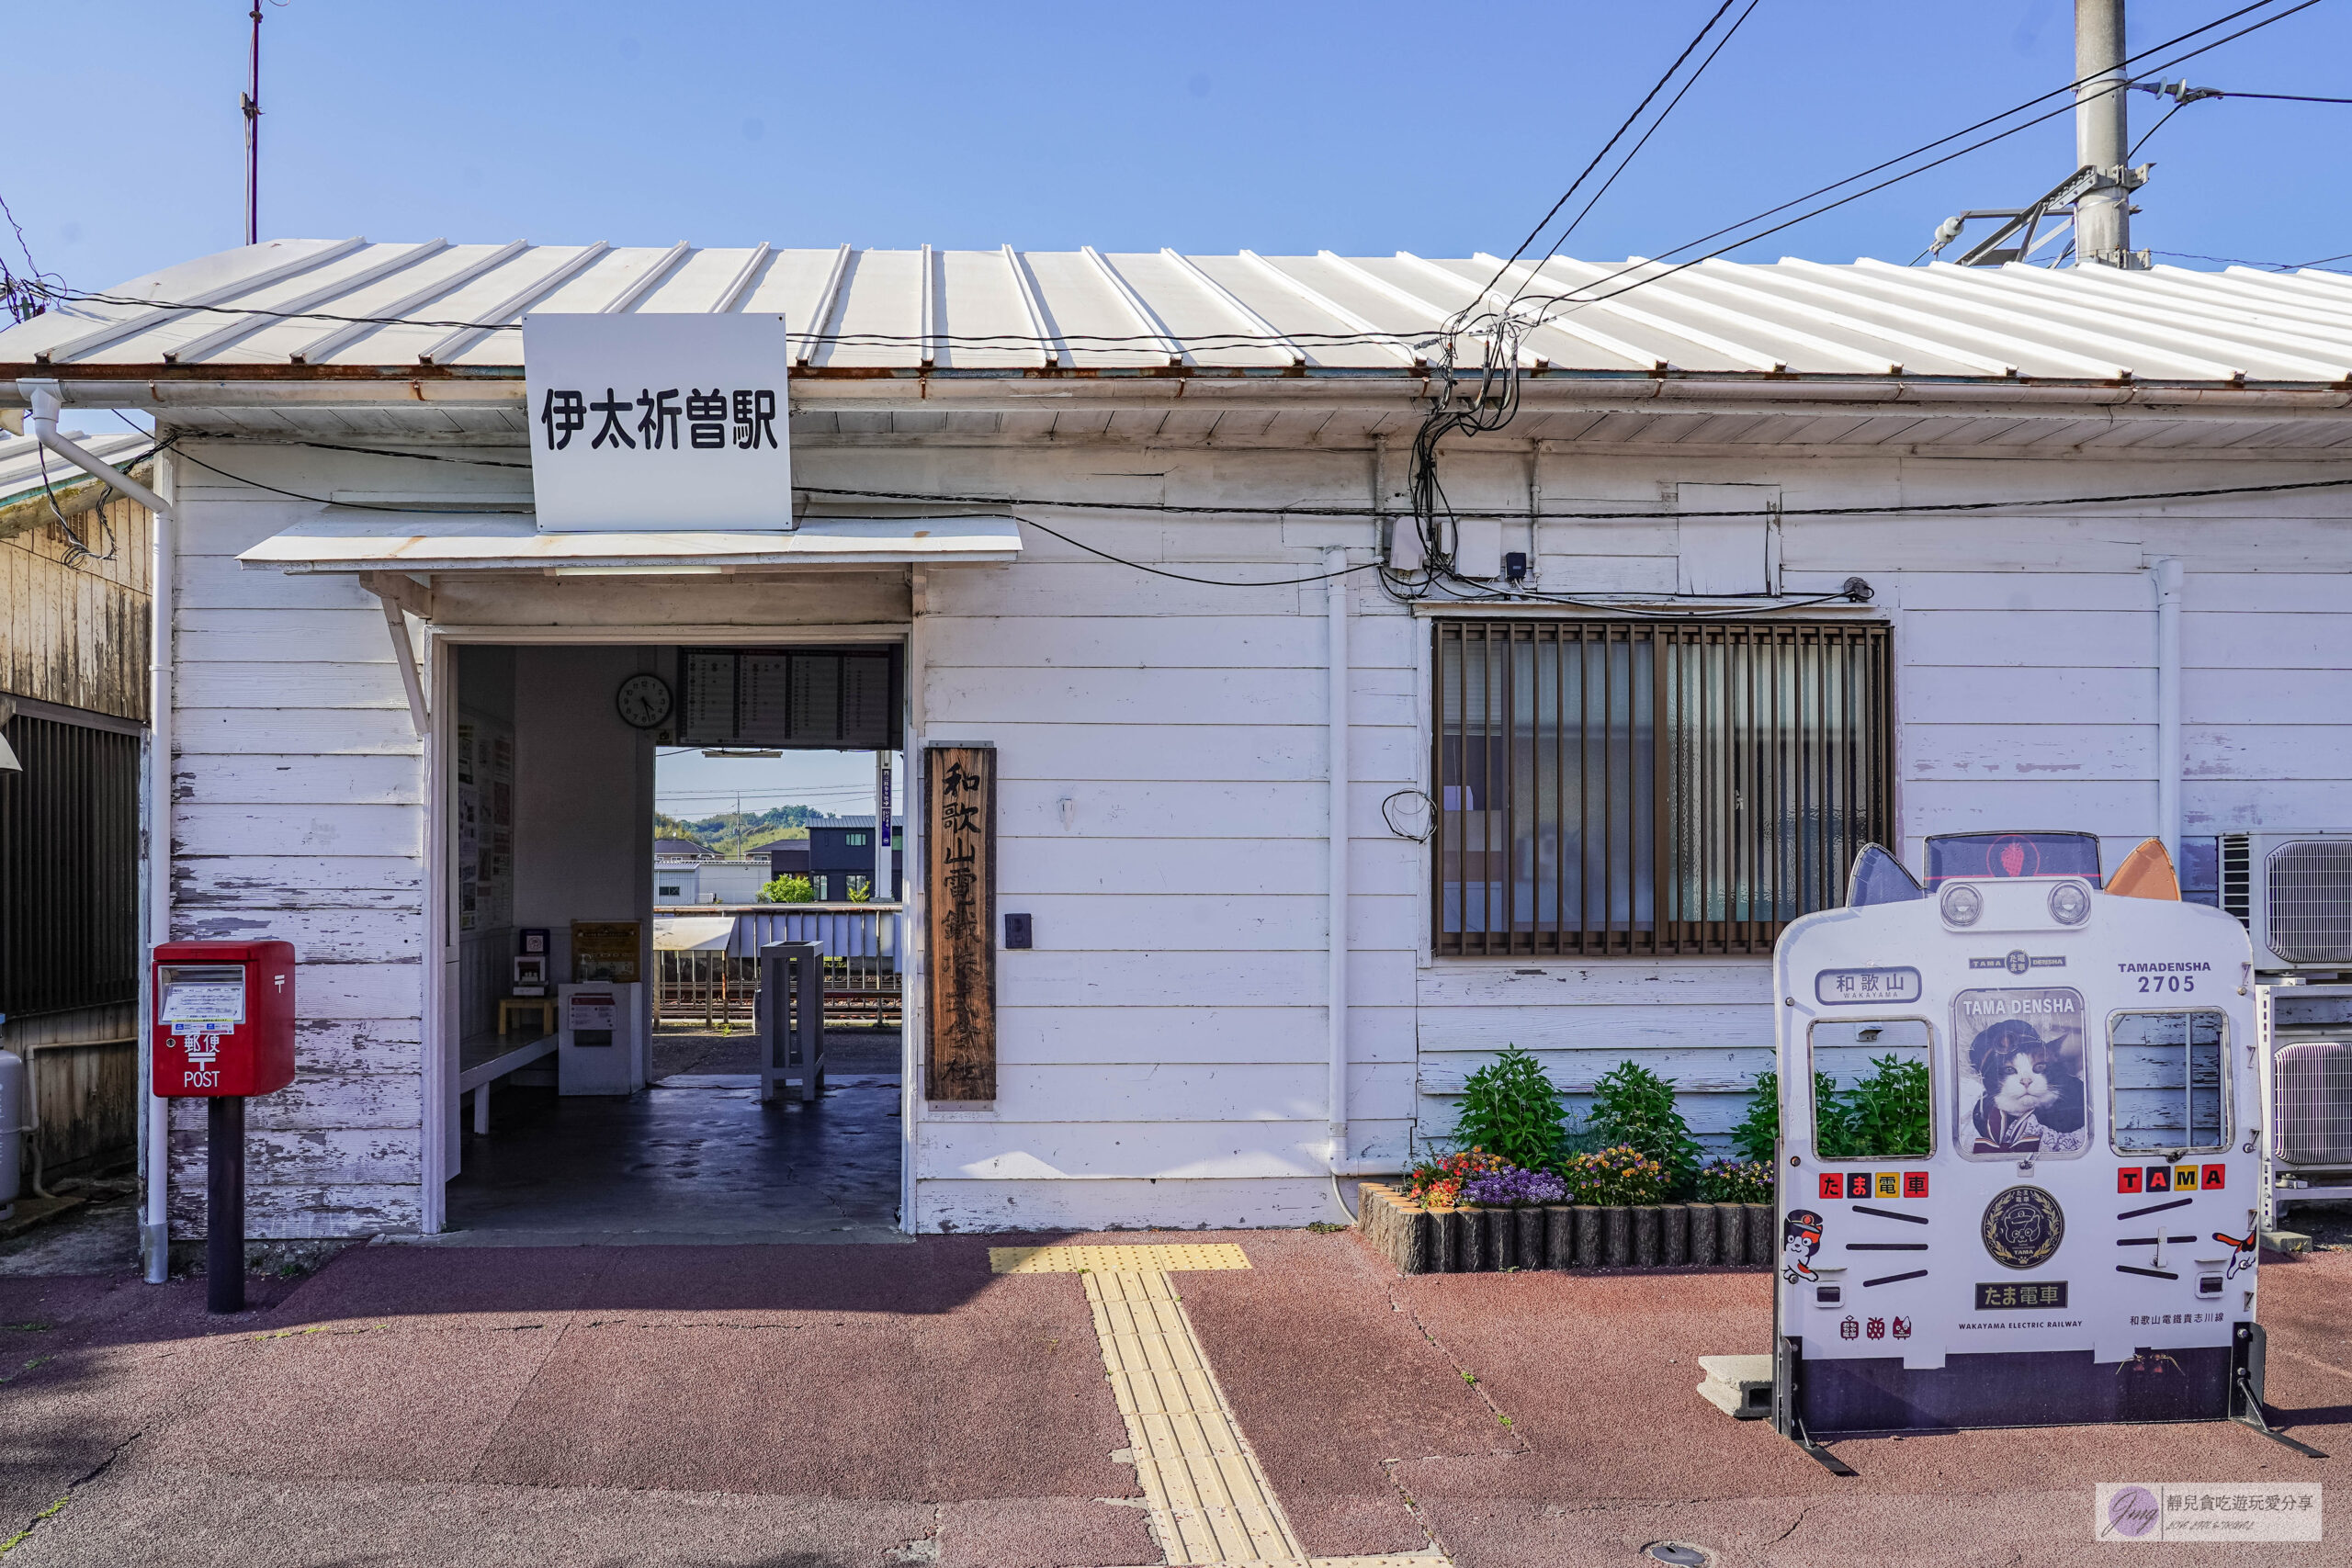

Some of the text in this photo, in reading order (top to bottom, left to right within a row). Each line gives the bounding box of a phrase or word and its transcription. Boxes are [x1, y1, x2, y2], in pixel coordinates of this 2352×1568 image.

[541, 388, 778, 450] 伊太祈曽駅
[2118, 962, 2211, 973] TAMADENSHA
[1837, 974, 1905, 992] 和歌山
[2138, 975, 2195, 993] 2705
[1963, 998, 2075, 1015] TAMA DENSHA
[184, 1034, 220, 1053] 郵便
[184, 1071, 220, 1088] POST
[1825, 1176, 1925, 1195] たま電車
[2123, 1170, 2221, 1188] TAMA
[1985, 1285, 2058, 1305] たま電車
[2008, 1321, 2044, 1329] ELECTRIC
[2047, 1320, 2083, 1328] RAILWAY
[2130, 1312, 2223, 1325] 和歌山電鐵貴志川線
